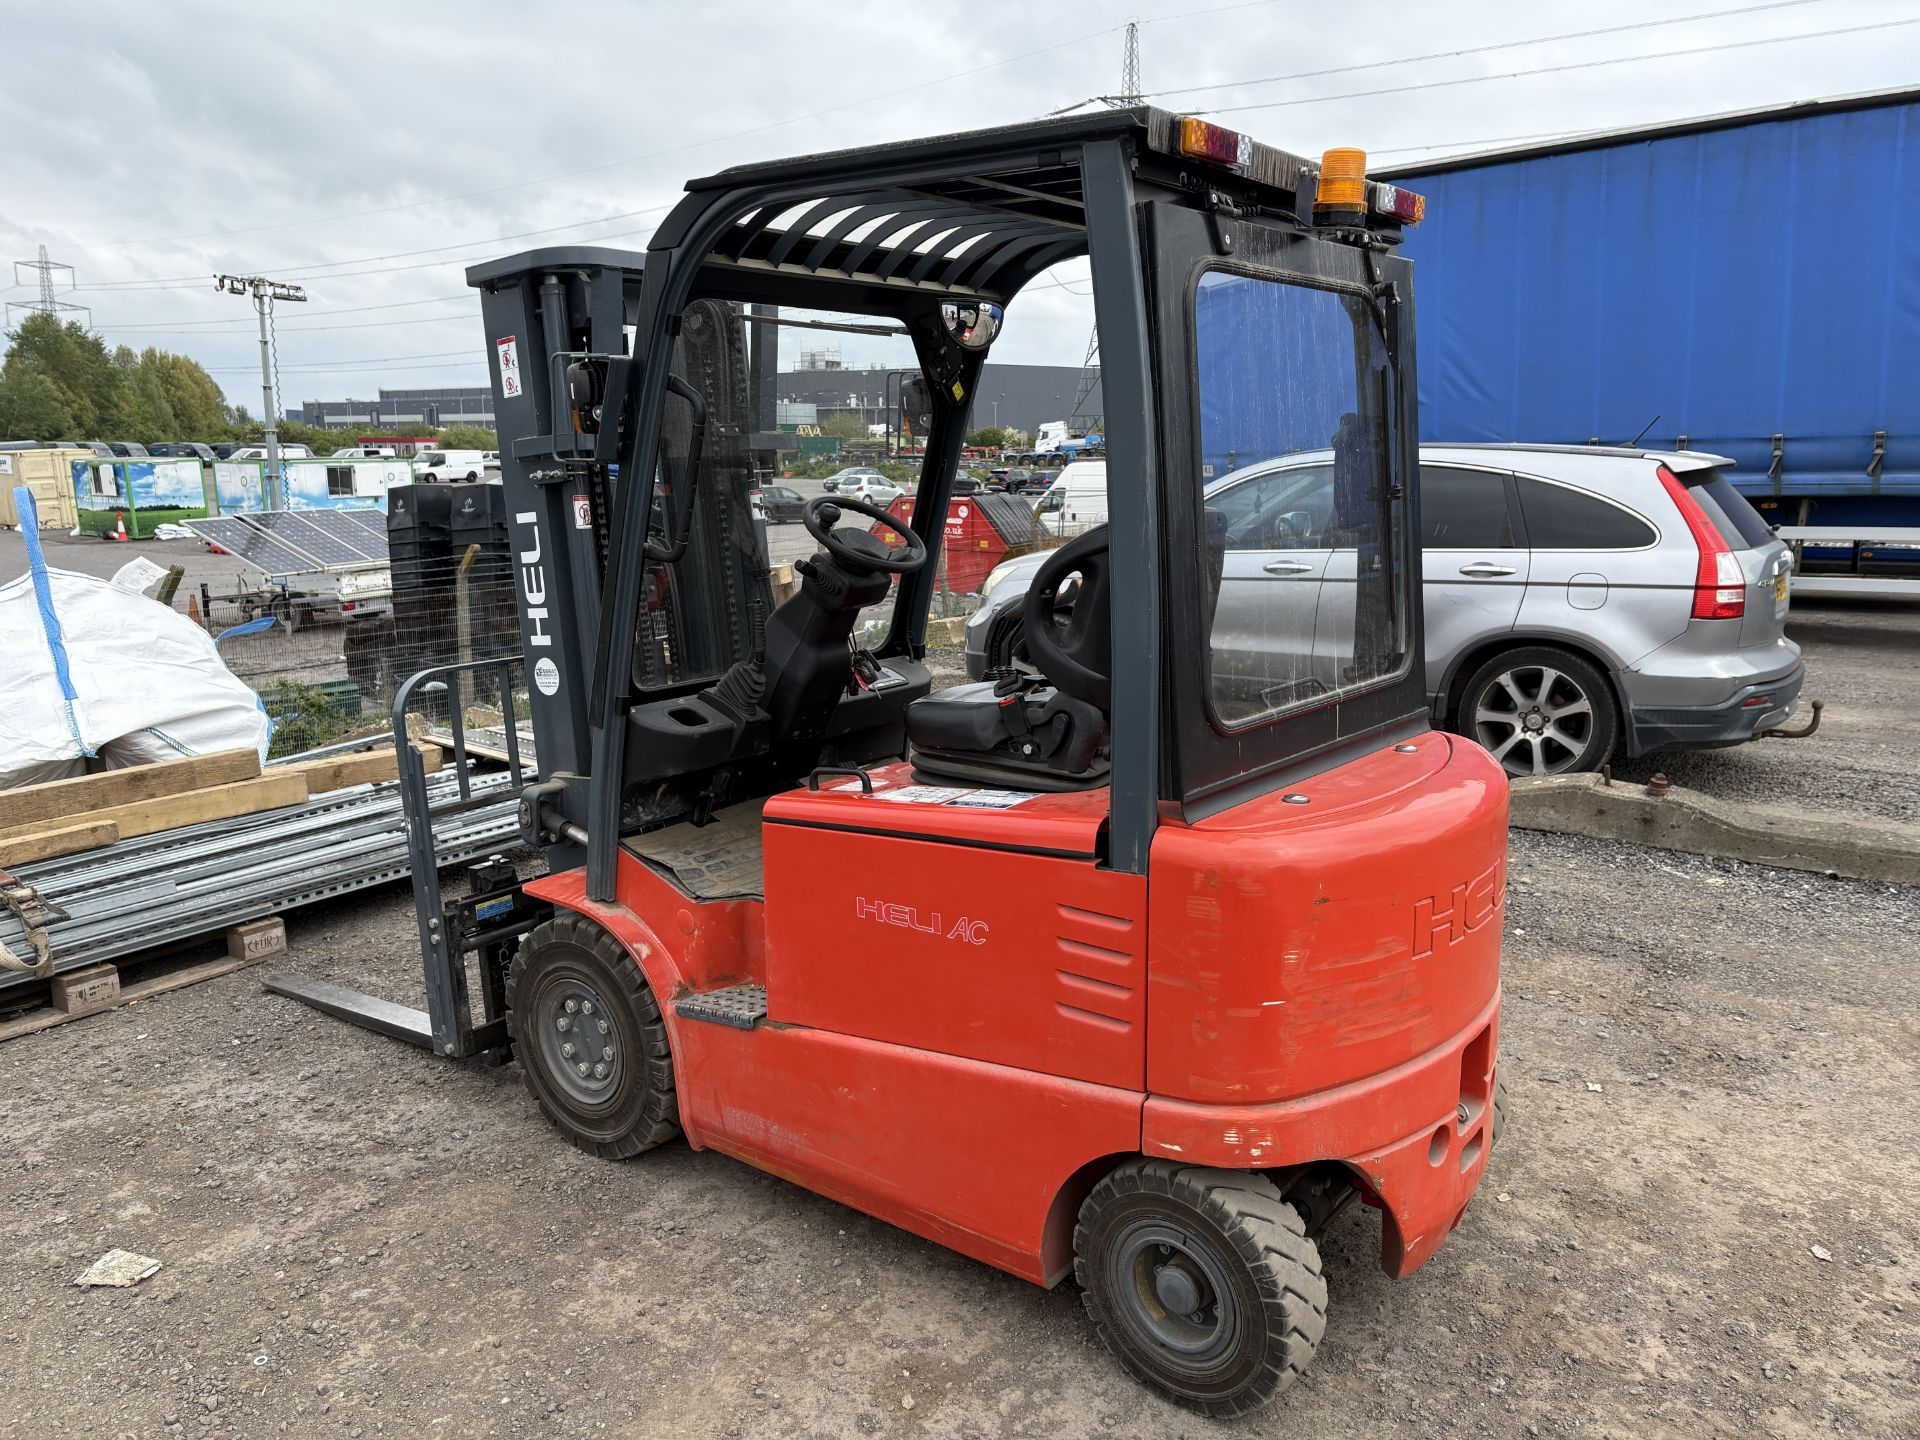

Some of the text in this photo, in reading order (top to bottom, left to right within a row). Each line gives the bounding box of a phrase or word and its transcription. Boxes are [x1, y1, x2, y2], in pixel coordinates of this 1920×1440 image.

[943, 525, 964, 534] o.uk
[516, 511, 552, 646] HELI
[856, 896, 989, 945] HELI AC
[1411, 857, 1507, 961] HEL
